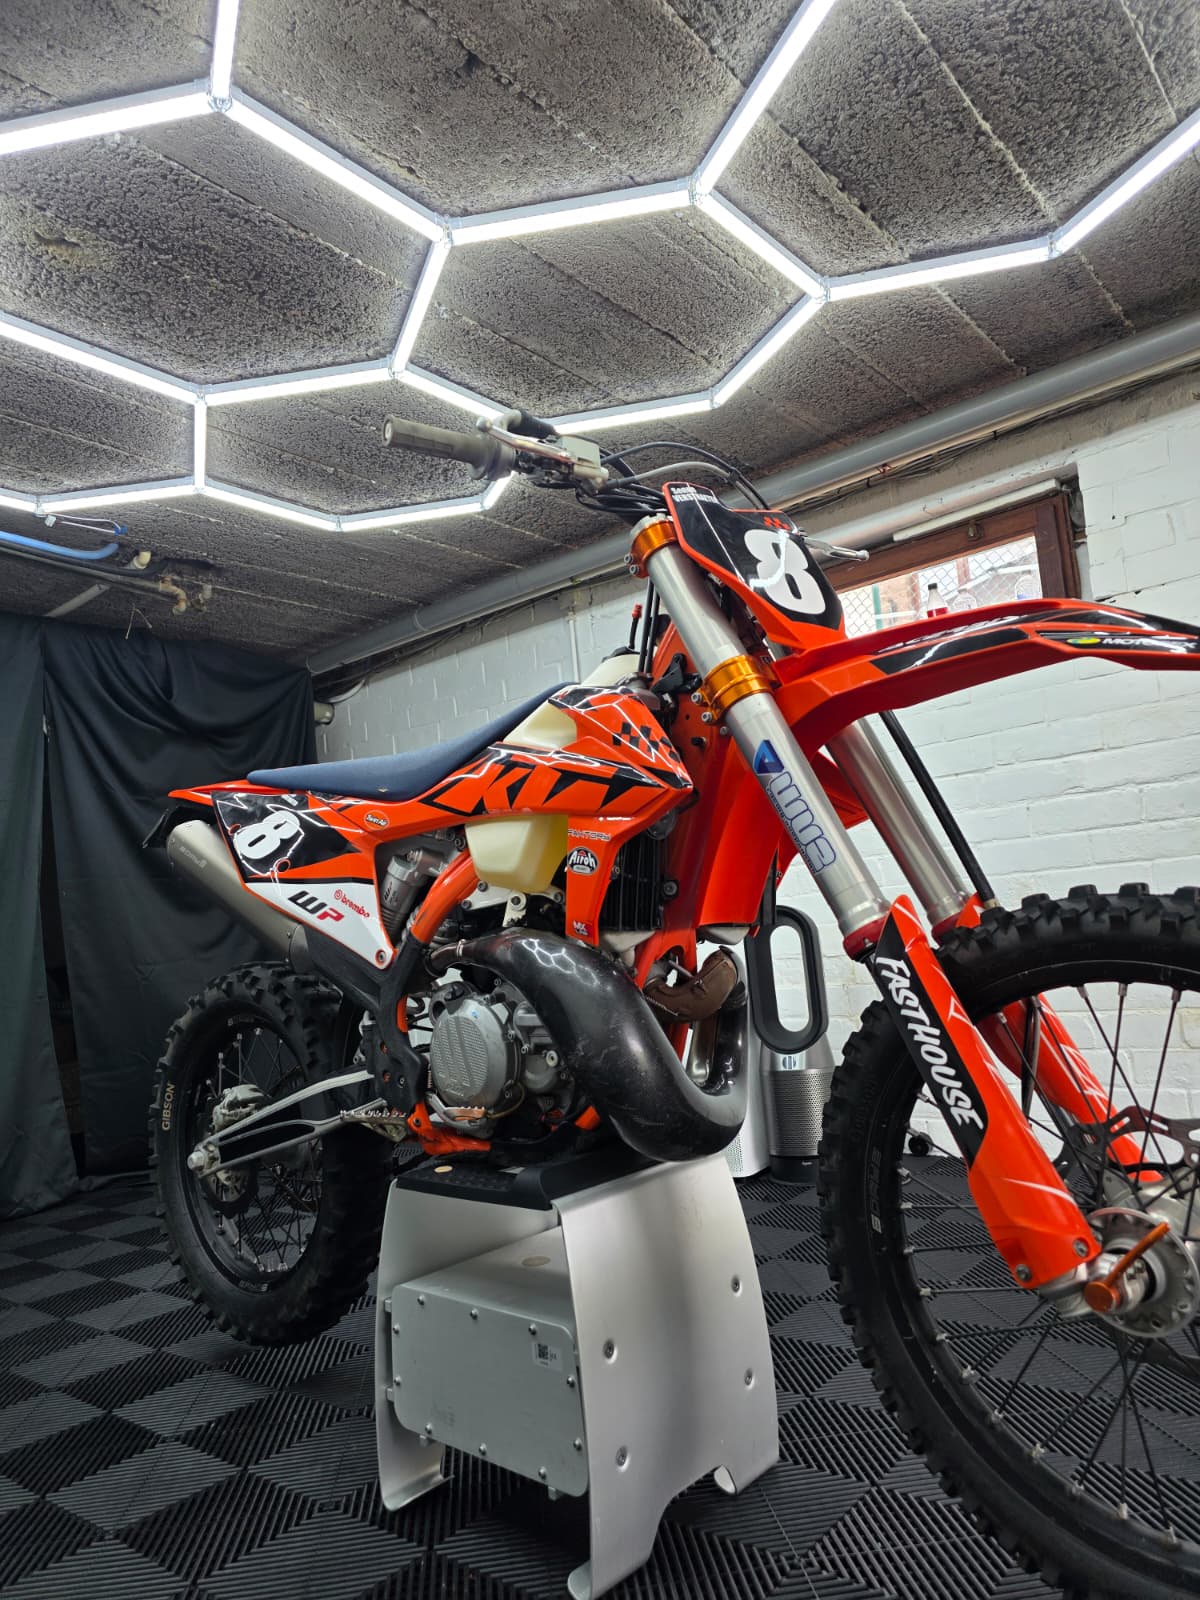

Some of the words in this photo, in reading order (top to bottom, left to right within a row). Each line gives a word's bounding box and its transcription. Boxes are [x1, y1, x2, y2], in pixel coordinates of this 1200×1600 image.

[744, 529, 826, 614] 8
[233, 809, 301, 860] 8
[568, 850, 597, 869] Airoh
[287, 889, 345, 922] WP
[340, 893, 370, 919] brembo
[875, 956, 984, 1131] FASTHOUSE
[161, 1082, 176, 1131] GIBSON
